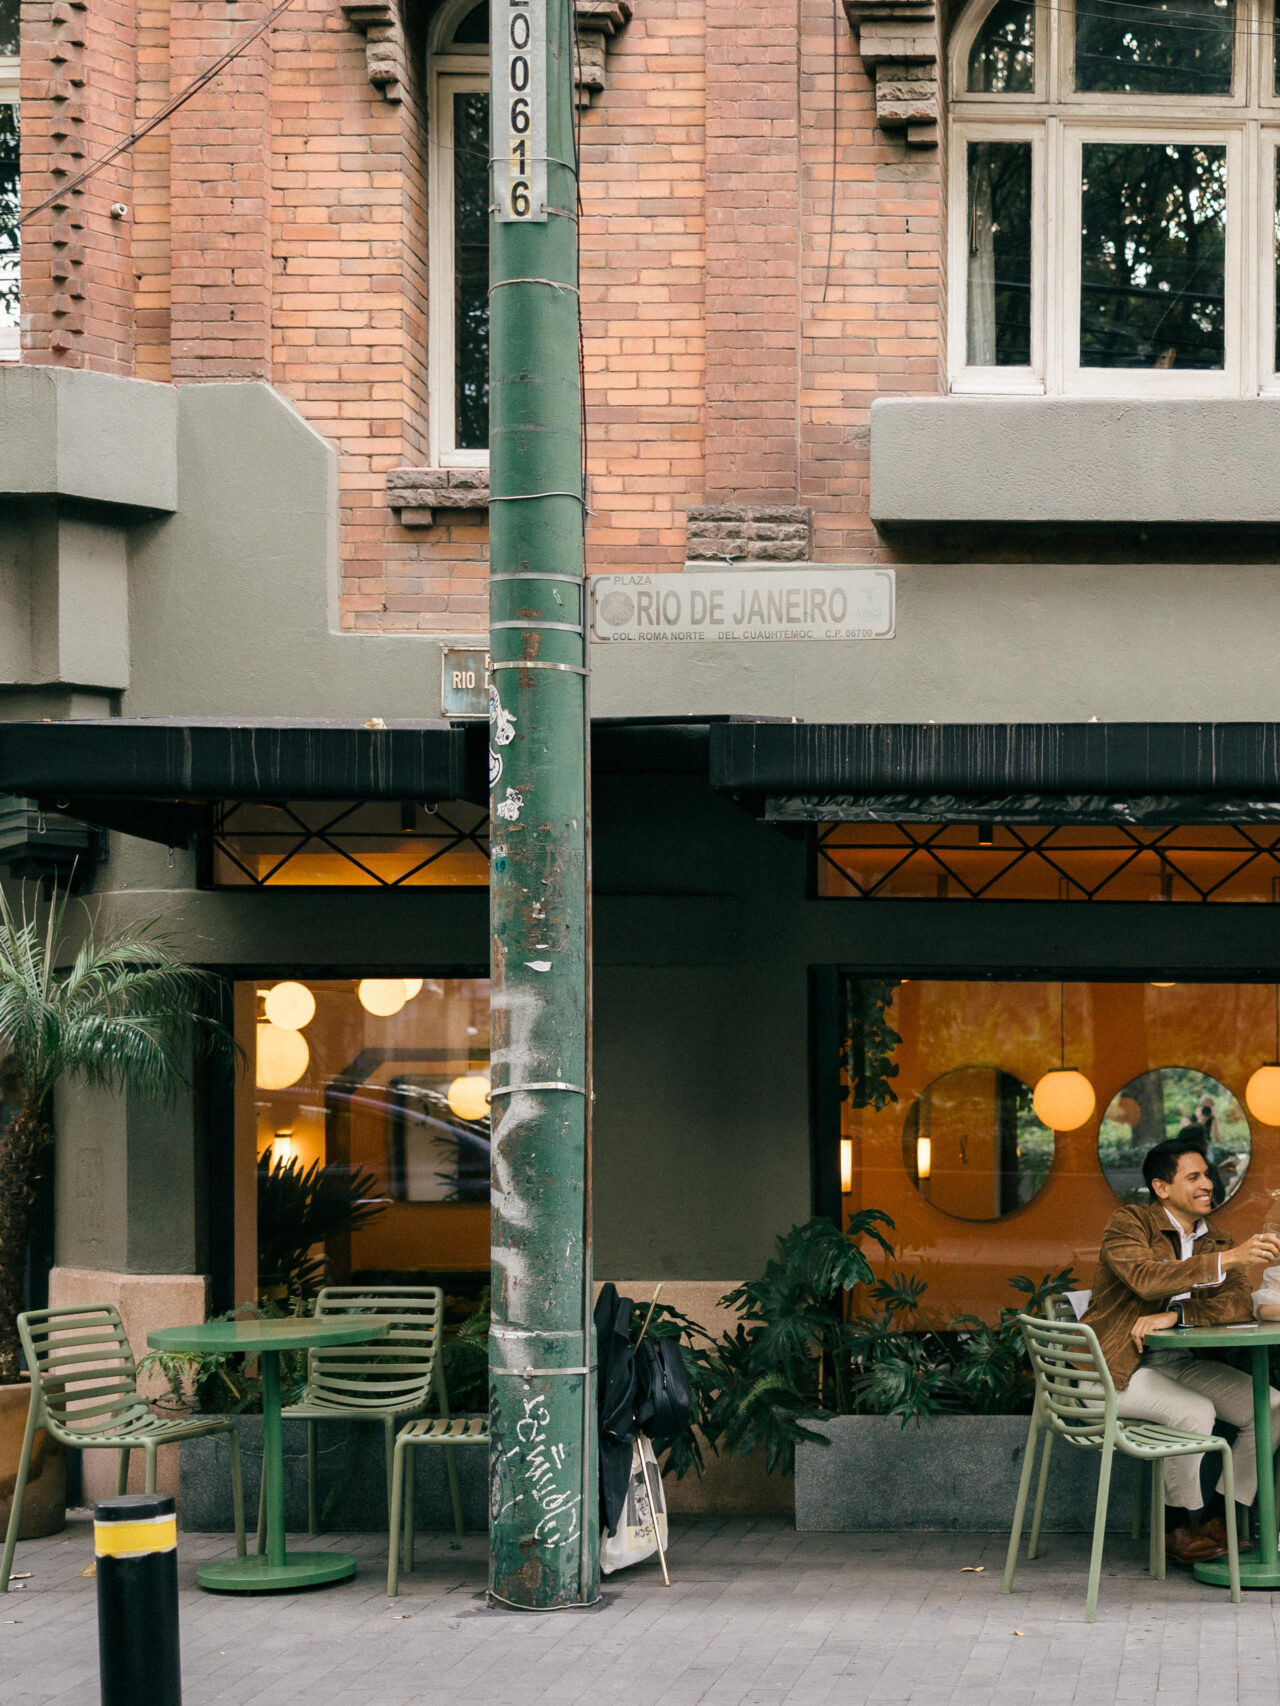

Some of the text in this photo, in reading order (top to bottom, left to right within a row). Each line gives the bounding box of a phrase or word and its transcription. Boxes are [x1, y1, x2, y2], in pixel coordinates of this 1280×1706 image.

[509, 0, 530, 217] 00616
[613, 576, 652, 585] PLAZA
[637, 587, 848, 626] RIO DE JANEIRO
[612, 632, 636, 640] COL.
[638, 632, 669, 640] ROMA
[670, 631, 705, 640] NORTE
[717, 631, 740, 640] DEL.
[824, 629, 843, 639] C.P.
[845, 629, 873, 638] 06700
[453, 671, 475, 688] RIO
